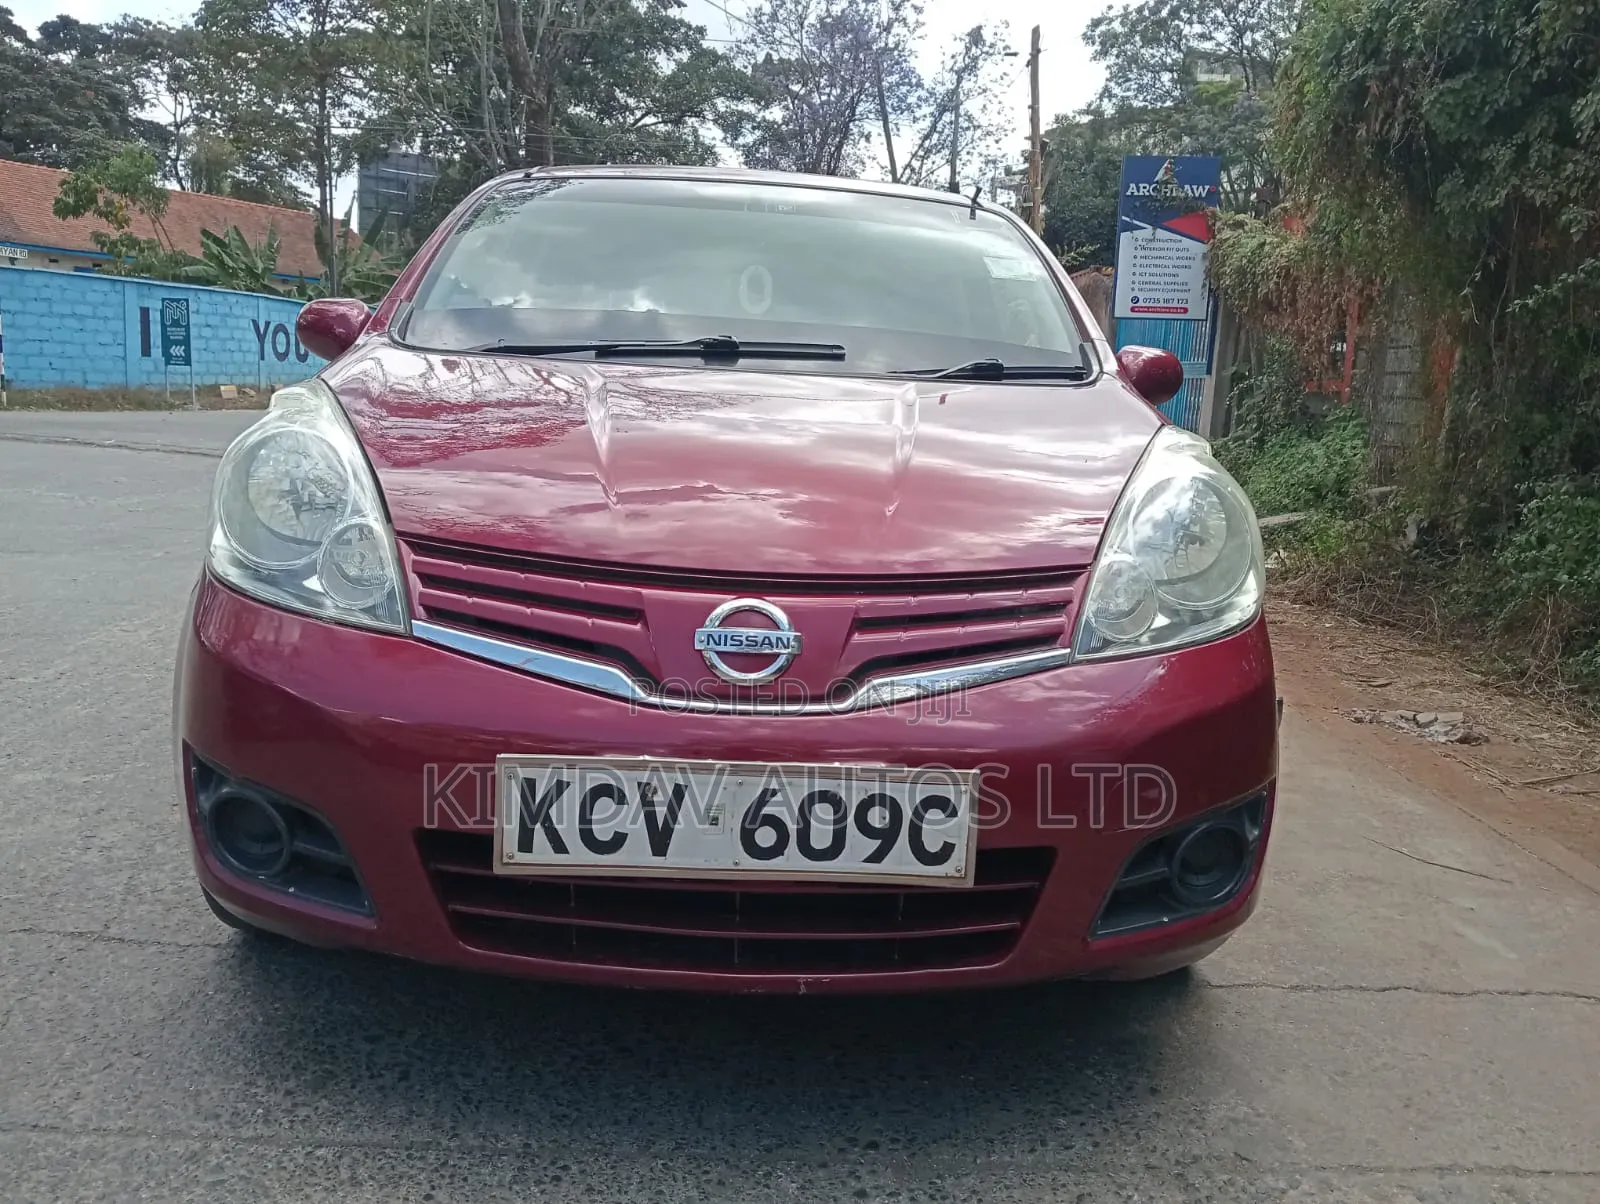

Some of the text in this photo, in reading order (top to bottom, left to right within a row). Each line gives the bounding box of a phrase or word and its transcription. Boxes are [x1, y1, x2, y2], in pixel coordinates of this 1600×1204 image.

[705, 633, 791, 650] NISSAN
[516, 776, 960, 867] KCV 609C
